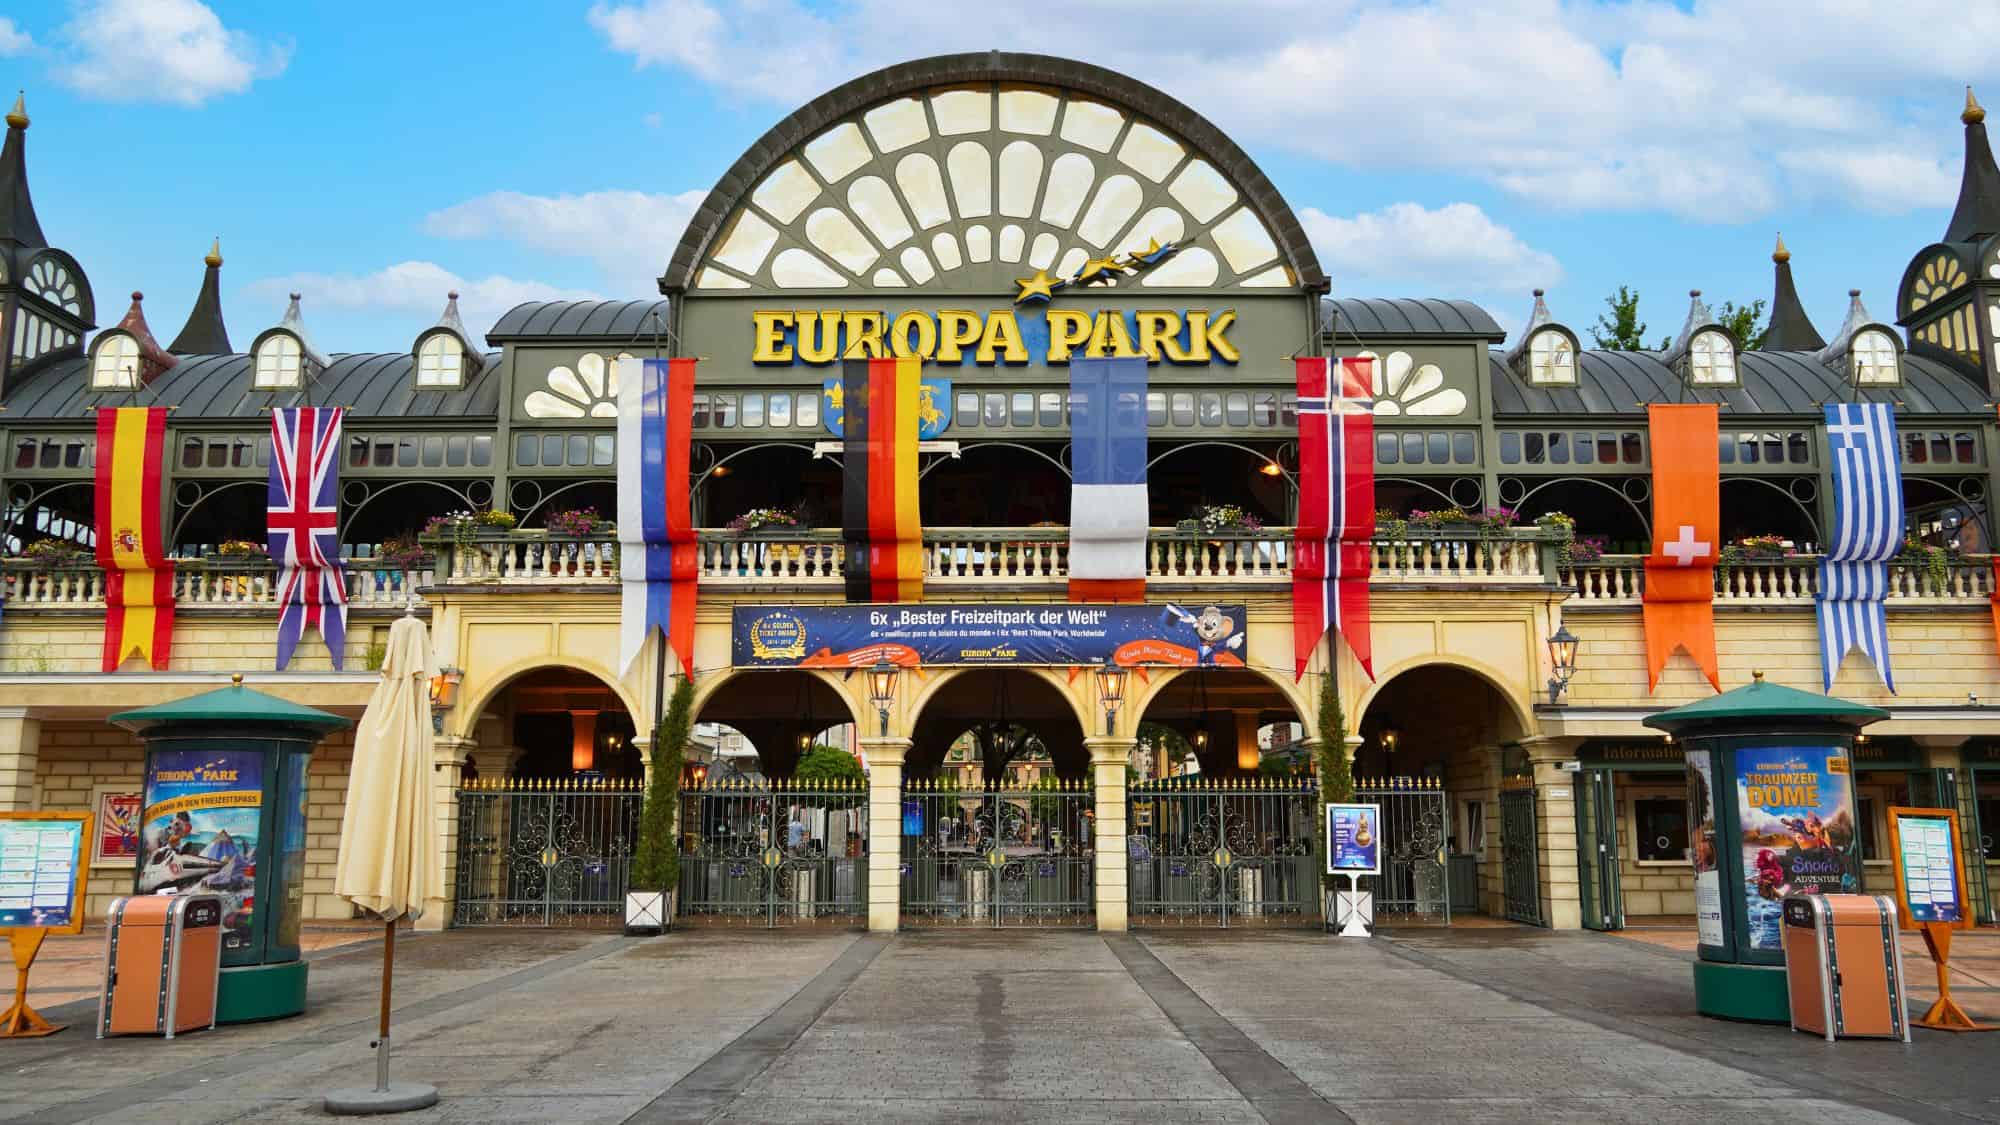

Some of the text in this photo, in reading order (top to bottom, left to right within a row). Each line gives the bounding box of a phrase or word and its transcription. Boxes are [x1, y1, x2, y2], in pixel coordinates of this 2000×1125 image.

[752, 309, 1241, 366] EUROPA PARK
[870, 611, 888, 625] 6x
[951, 609, 1035, 627] Freizeitpark
[1040, 609, 1063, 625] der
[203, 770, 238, 781] PARK
[1747, 772, 1819, 785] TRAUMZEIT
[1747, 785, 1820, 808] DOME
